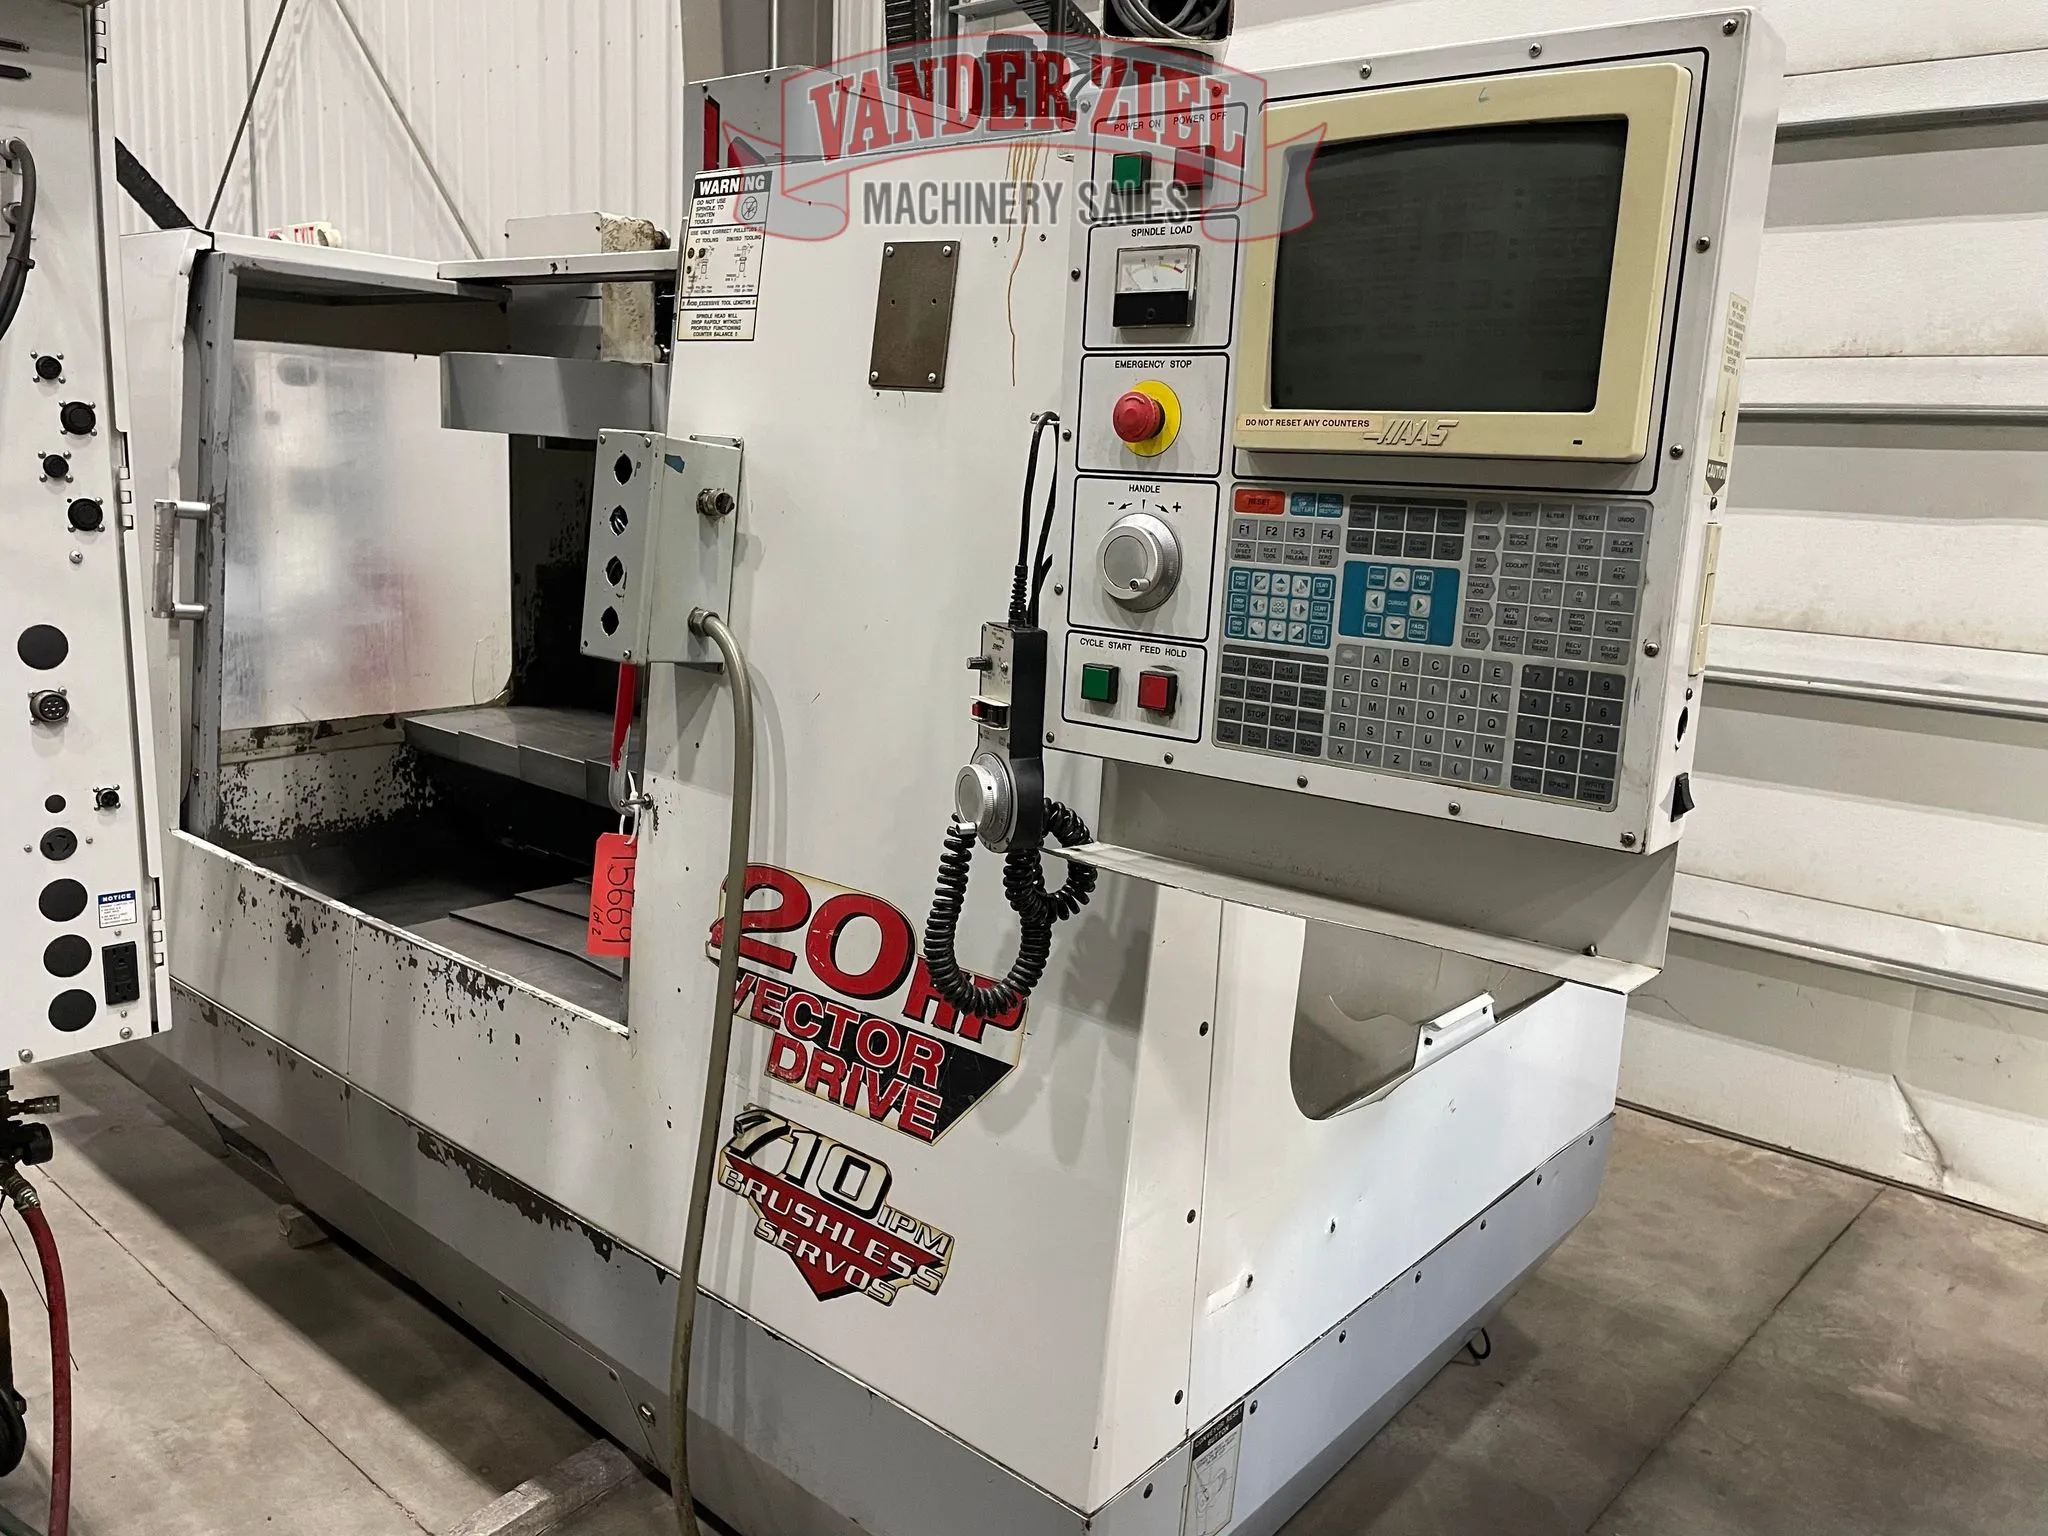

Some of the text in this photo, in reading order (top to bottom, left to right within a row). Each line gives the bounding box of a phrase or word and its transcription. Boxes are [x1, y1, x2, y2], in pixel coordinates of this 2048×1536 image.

[1173, 111, 1227, 126] POWER OFF
[1113, 119, 1161, 132] POWER ON
[700, 174, 765, 196] WARNING
[1131, 225, 1193, 238] SPINDLE LOAD
[1114, 360, 1192, 369] EMERGENCY STOP
[1245, 418, 1256, 426] DO
[1258, 418, 1274, 426] NOT
[1275, 419, 1302, 427] RESET
[1322, 420, 1370, 428] COUNTERS
[1128, 484, 1160, 494] HANDLE
[1240, 524, 1250, 534] F1
[1265, 526, 1278, 536] F2
[1292, 528, 1306, 538] F3
[1320, 530, 1334, 540] F4
[1080, 638, 1132, 651] CYCLE START
[1140, 645, 1187, 658] FEED HOLD
[1373, 654, 1380, 664] A
[1402, 658, 1409, 666] B
[1431, 661, 1440, 670] C
[1462, 665, 1470, 674] D
[1494, 669, 1501, 677] E
[1534, 672, 1540, 682] 7
[1343, 675, 1350, 684] F
[1371, 678, 1378, 688] G
[1568, 677, 1574, 686] 8
[1400, 683, 1407, 691] H
[1604, 681, 1610, 691] 9
[1459, 690, 1467, 699] J
[1491, 694, 1498, 703] K
[1341, 699, 1347, 708] L
[1368, 702, 1377, 711] M
[1530, 698, 1537, 708] 4
[1565, 703, 1571, 713] 5
[1224, 706, 1236, 714] CW
[1247, 710, 1266, 718] STOP
[1397, 706, 1405, 715] N
[1426, 710, 1435, 720] O
[1600, 708, 1607, 717] 6
[1274, 713, 1292, 722] CCW
[1457, 714, 1464, 723] P
[1338, 722, 1346, 732] R
[1487, 719, 1496, 728] Q
[1366, 726, 1374, 736] S
[1395, 731, 1402, 739] T
[1561, 729, 1568, 739] 2
[1424, 735, 1432, 744] U
[1455, 739, 1462, 748] V
[1597, 734, 1603, 744] 3
[1337, 745, 1343, 754] X
[1484, 744, 1495, 753] W
[1365, 750, 1372, 759] Y
[1393, 754, 1400, 764] Z
[1559, 755, 1565, 765] 0
[102, 893, 132, 902] NOTICE
[709, 864, 916, 1001] 20
[767, 1030, 943, 1140] DRIVE
[728, 1109, 952, 1257] 710 IPM
[722, 1165, 944, 1295] BRUSHLESS
[754, 1217, 897, 1306] SERVOS
[1226, 1404, 1243, 1422] RESET
